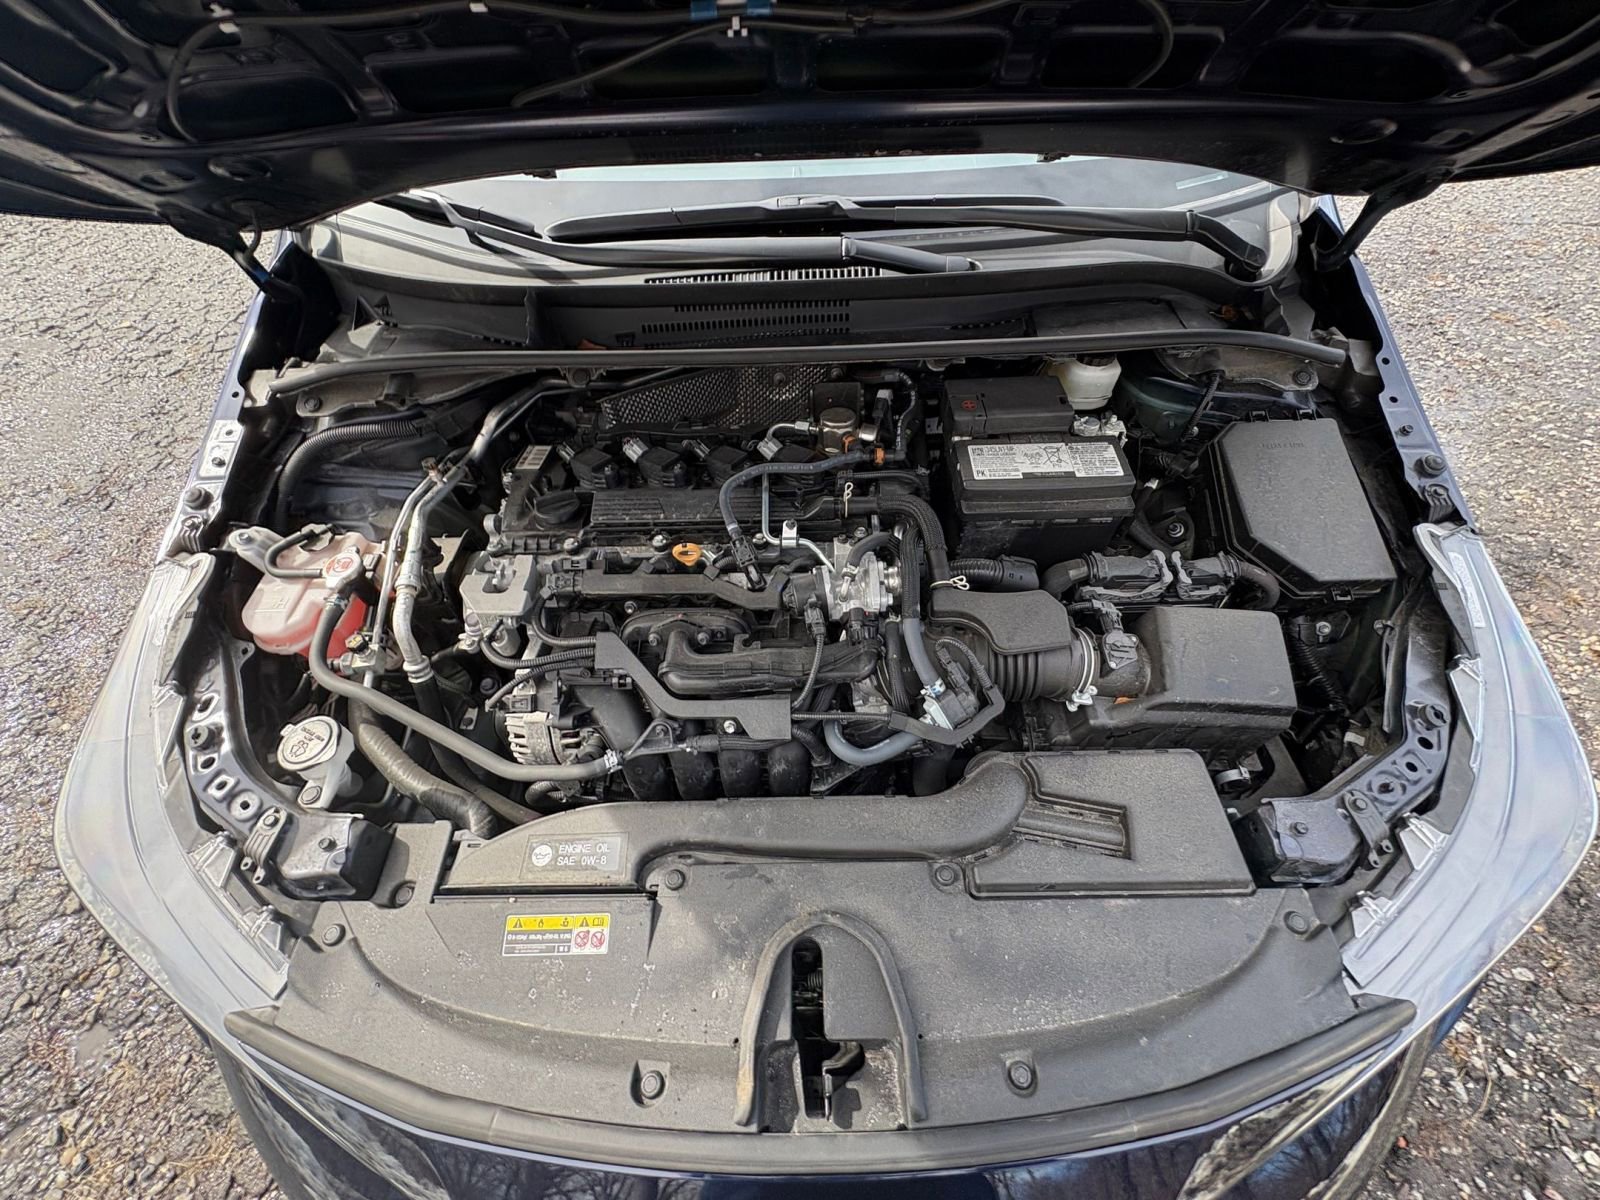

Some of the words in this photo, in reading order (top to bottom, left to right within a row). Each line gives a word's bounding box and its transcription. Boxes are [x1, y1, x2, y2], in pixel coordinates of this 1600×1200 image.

[976, 469, 986, 477] PK
[558, 844, 592, 854] ENGINE
[596, 843, 611, 853] OIL
[556, 856, 576, 865] SAE
[581, 855, 607, 865] 0W-8
